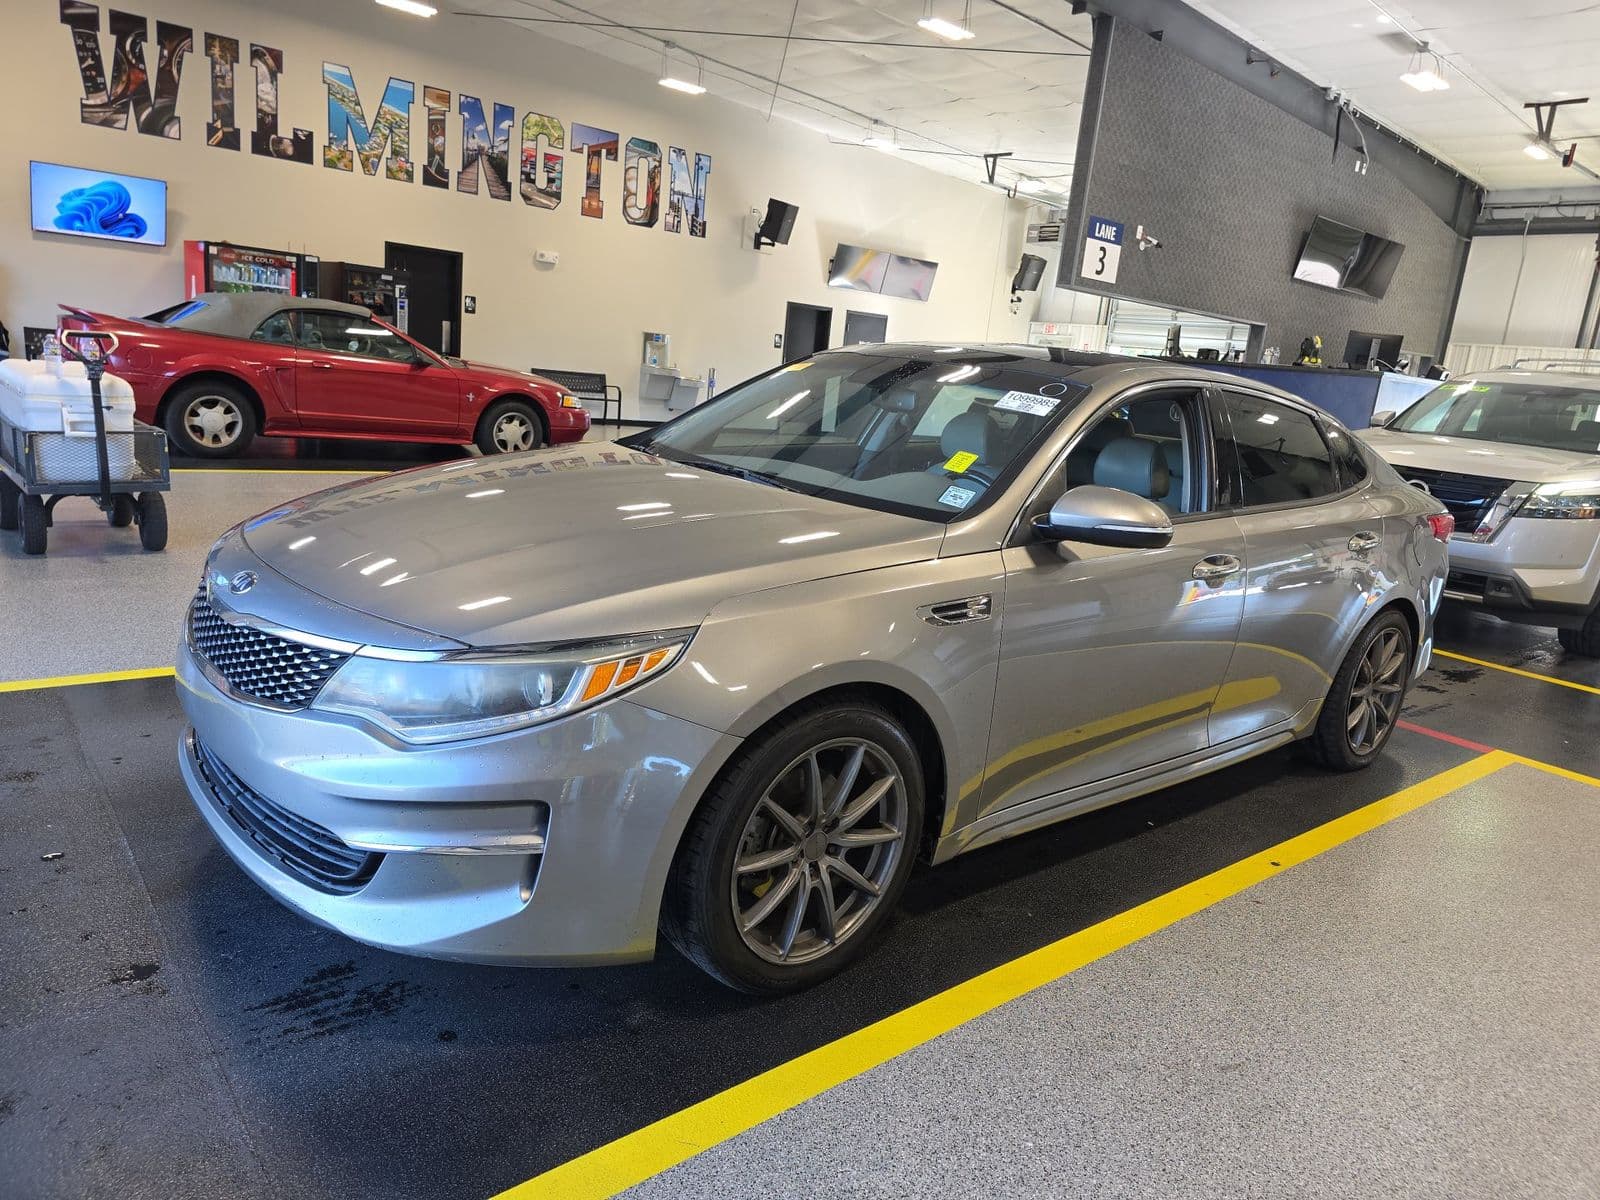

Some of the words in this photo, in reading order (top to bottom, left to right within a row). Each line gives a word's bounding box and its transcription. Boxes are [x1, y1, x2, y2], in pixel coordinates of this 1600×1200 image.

[60, 0, 711, 238] WILMINGTON
[1095, 222, 1117, 241] LANE
[255, 256, 274, 264] COLD
[1095, 246, 1107, 275] 3
